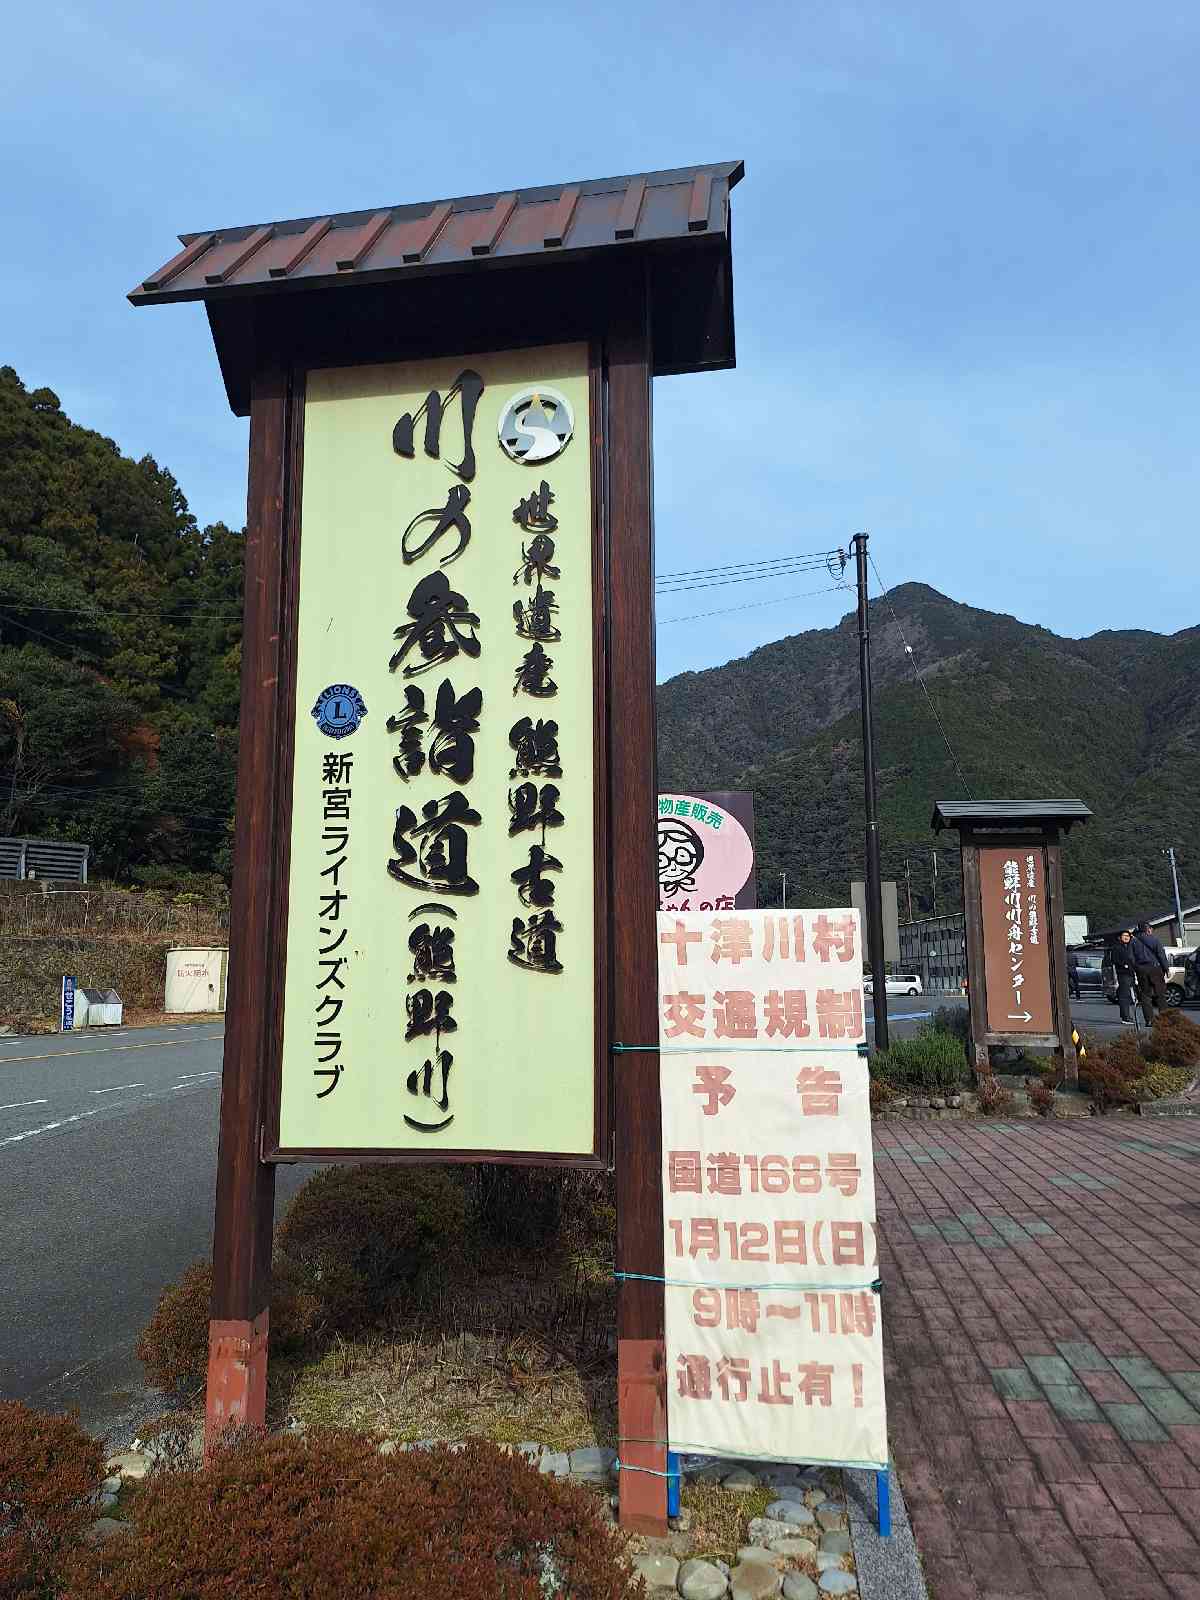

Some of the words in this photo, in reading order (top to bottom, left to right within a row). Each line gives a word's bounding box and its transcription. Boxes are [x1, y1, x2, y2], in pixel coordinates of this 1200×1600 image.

[658, 797, 725, 830] 物産販売
[313, 751, 353, 1099] 新宮ライオンズクラブ
[660, 915, 857, 965] 十津川村
[663, 989, 863, 1038] 交通規制
[668, 1151, 861, 1196] 国道168号
